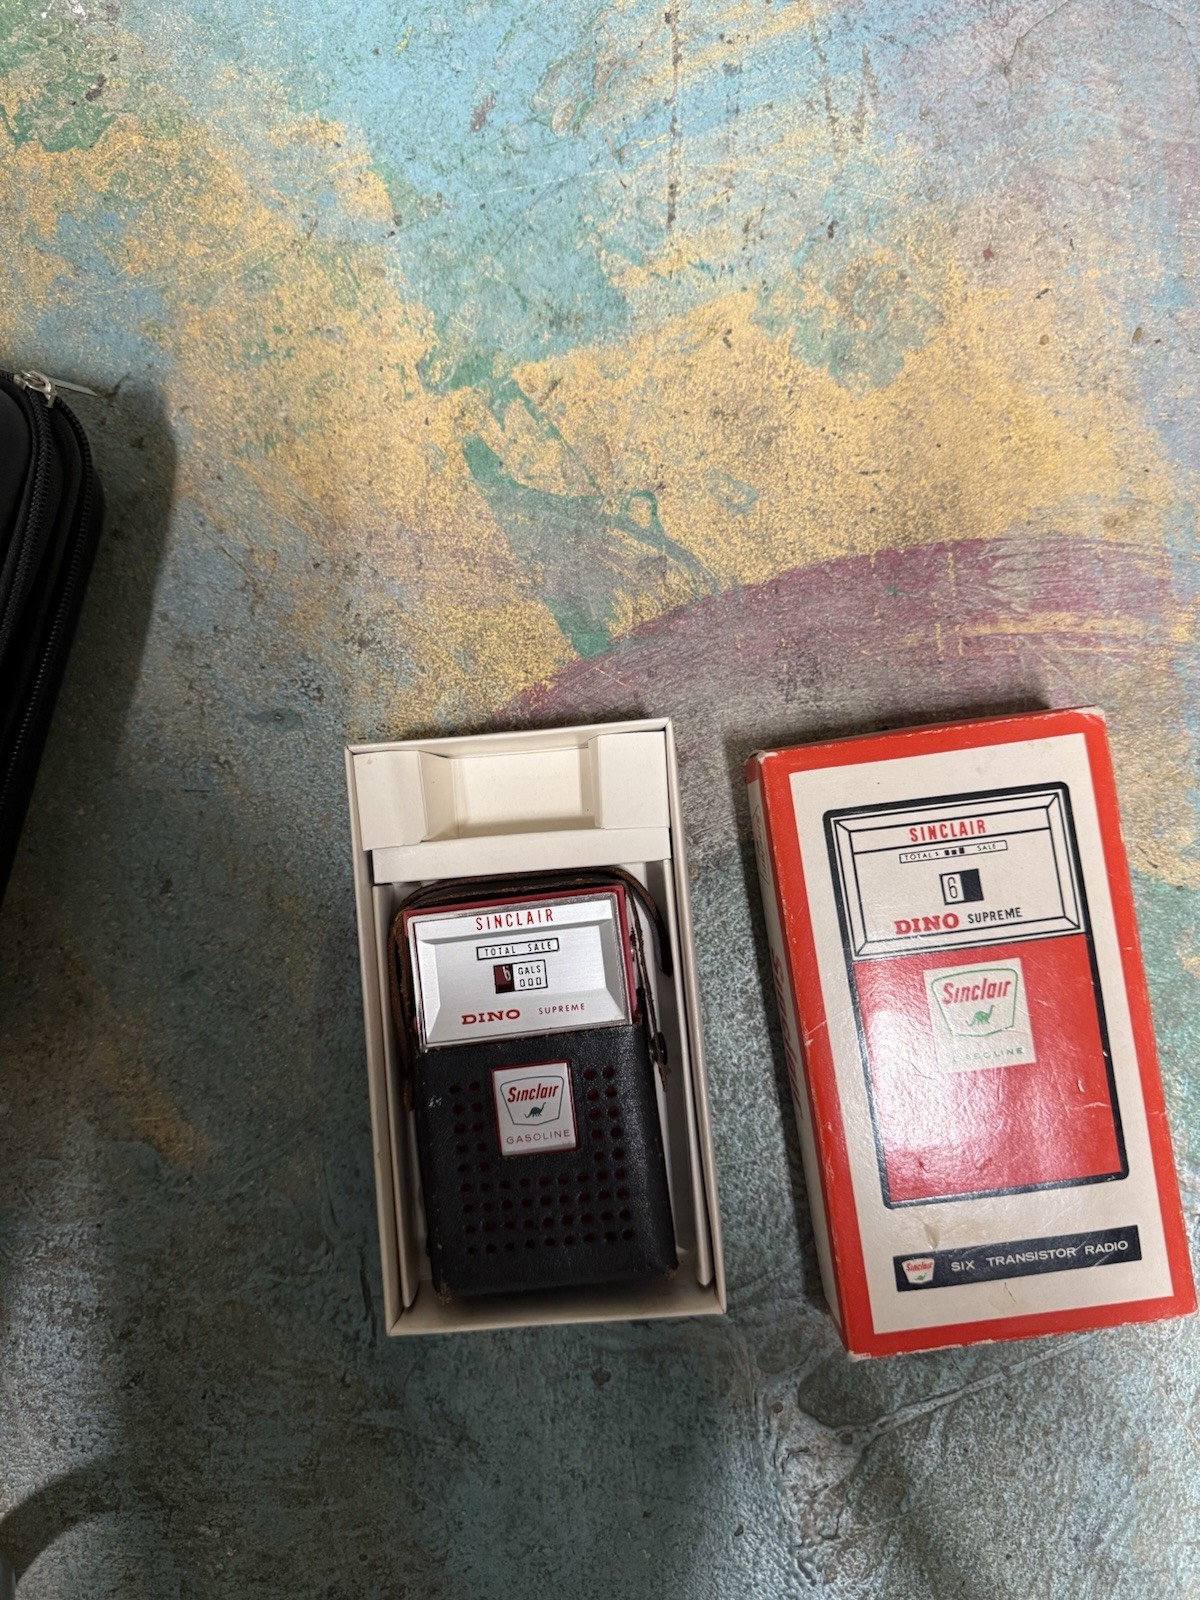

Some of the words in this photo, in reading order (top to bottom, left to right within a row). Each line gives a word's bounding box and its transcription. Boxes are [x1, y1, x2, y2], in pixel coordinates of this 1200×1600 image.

[909, 819, 986, 843] SINCLAIR
[905, 851, 932, 861] TOTAL
[977, 843, 996, 852] SALE
[947, 876, 958, 899] 6
[475, 908, 554, 931] SINCLAIR
[894, 912, 960, 935] DINO
[967, 907, 1023, 924] SUPREME
[485, 945, 516, 957] TOTAL
[527, 940, 552, 952] SALE
[517, 964, 541, 976] GALS
[942, 977, 1011, 1005] Sinclair
[461, 1008, 521, 1025] DINO
[538, 1002, 586, 1015] SUPREME
[769, 945, 804, 1120] Sinclair
[507, 1083, 559, 1103] Sinclair
[506, 1129, 571, 1145] GASOLINE
[951, 1259, 976, 1272] SIX
[986, 1247, 1077, 1267] TRANSISTOR
[1084, 1239, 1129, 1256] RADIO
